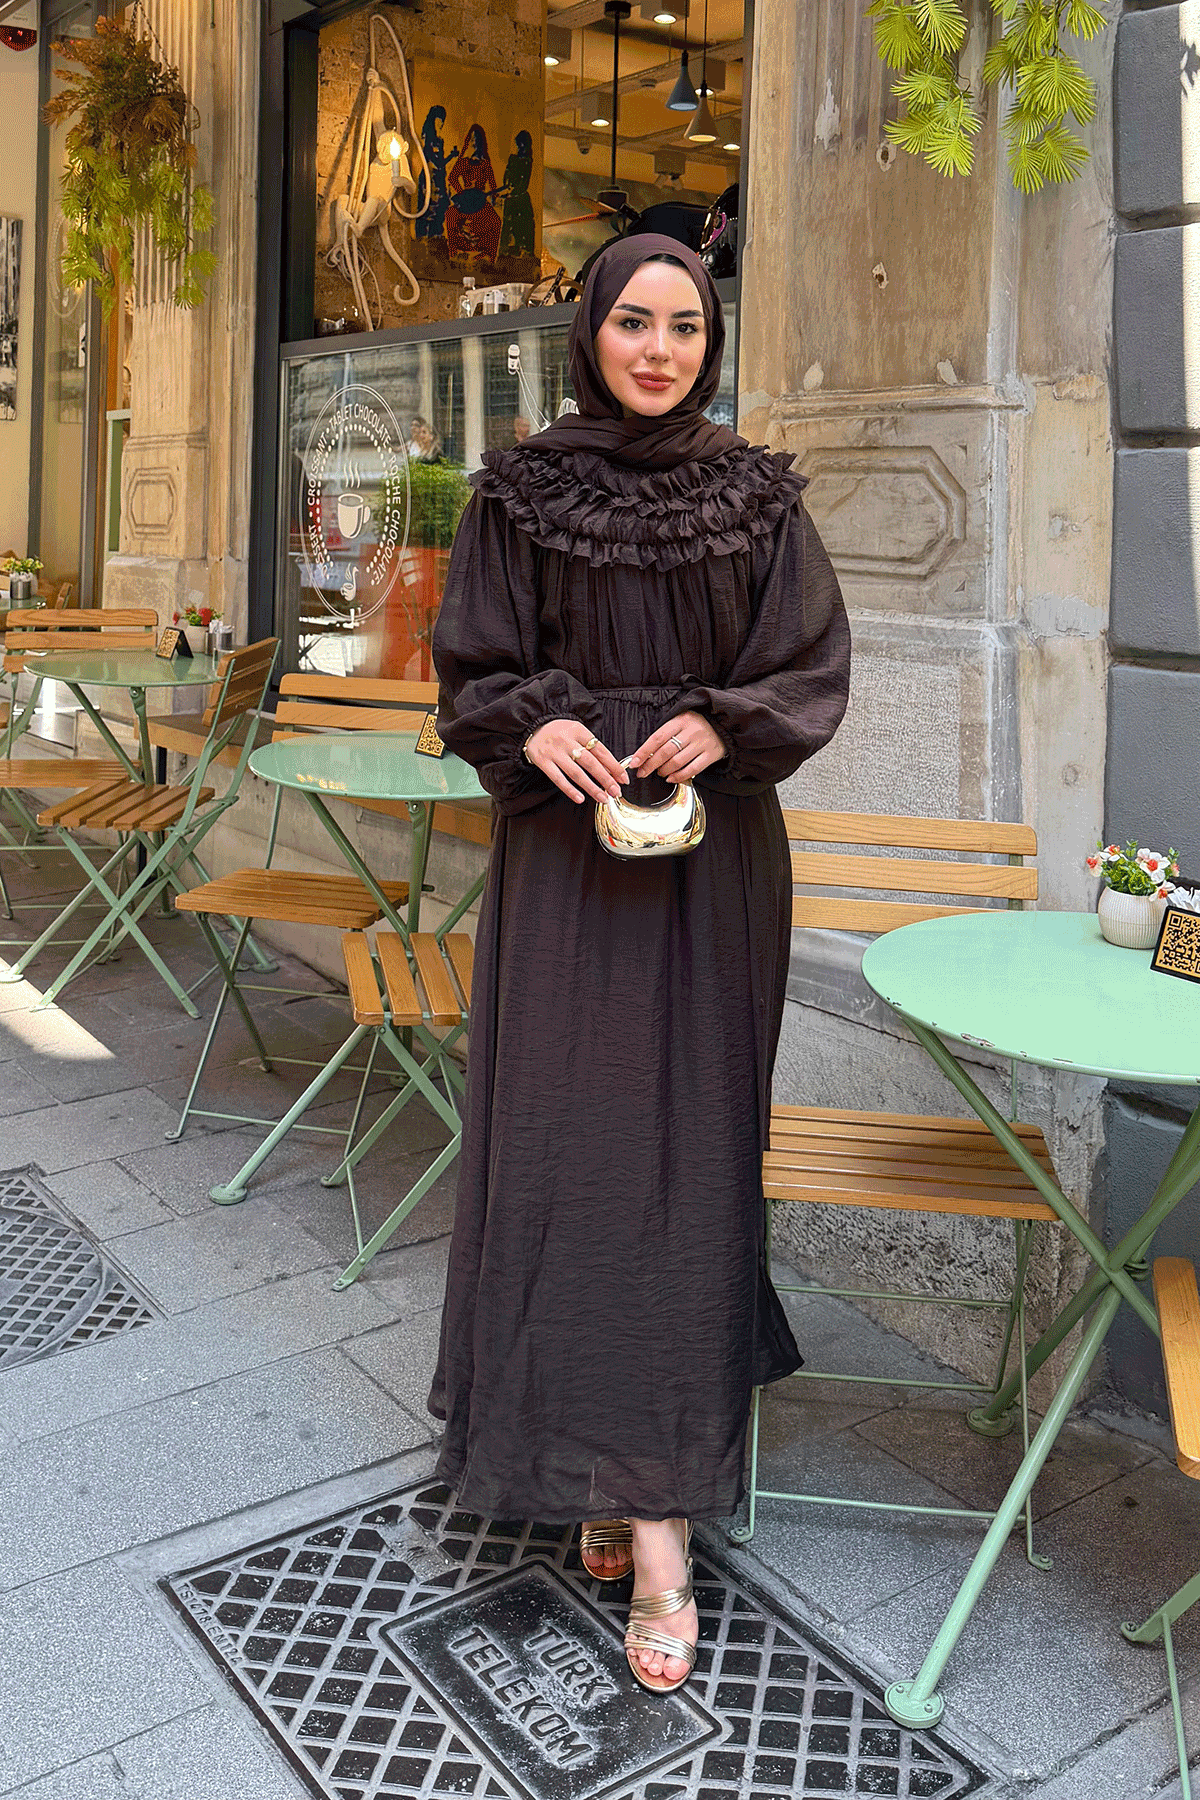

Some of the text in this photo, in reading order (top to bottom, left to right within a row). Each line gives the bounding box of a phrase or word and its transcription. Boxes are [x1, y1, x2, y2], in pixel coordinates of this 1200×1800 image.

[329, 403, 392, 449] TABLET CHOCOLATE
[307, 432, 328, 506] CROISSANT
[373, 454, 401, 585] ROCHE CHOCOLATE
[450, 1626, 595, 1766] TELEKOM
[524, 1624, 617, 1706] TÜRK
